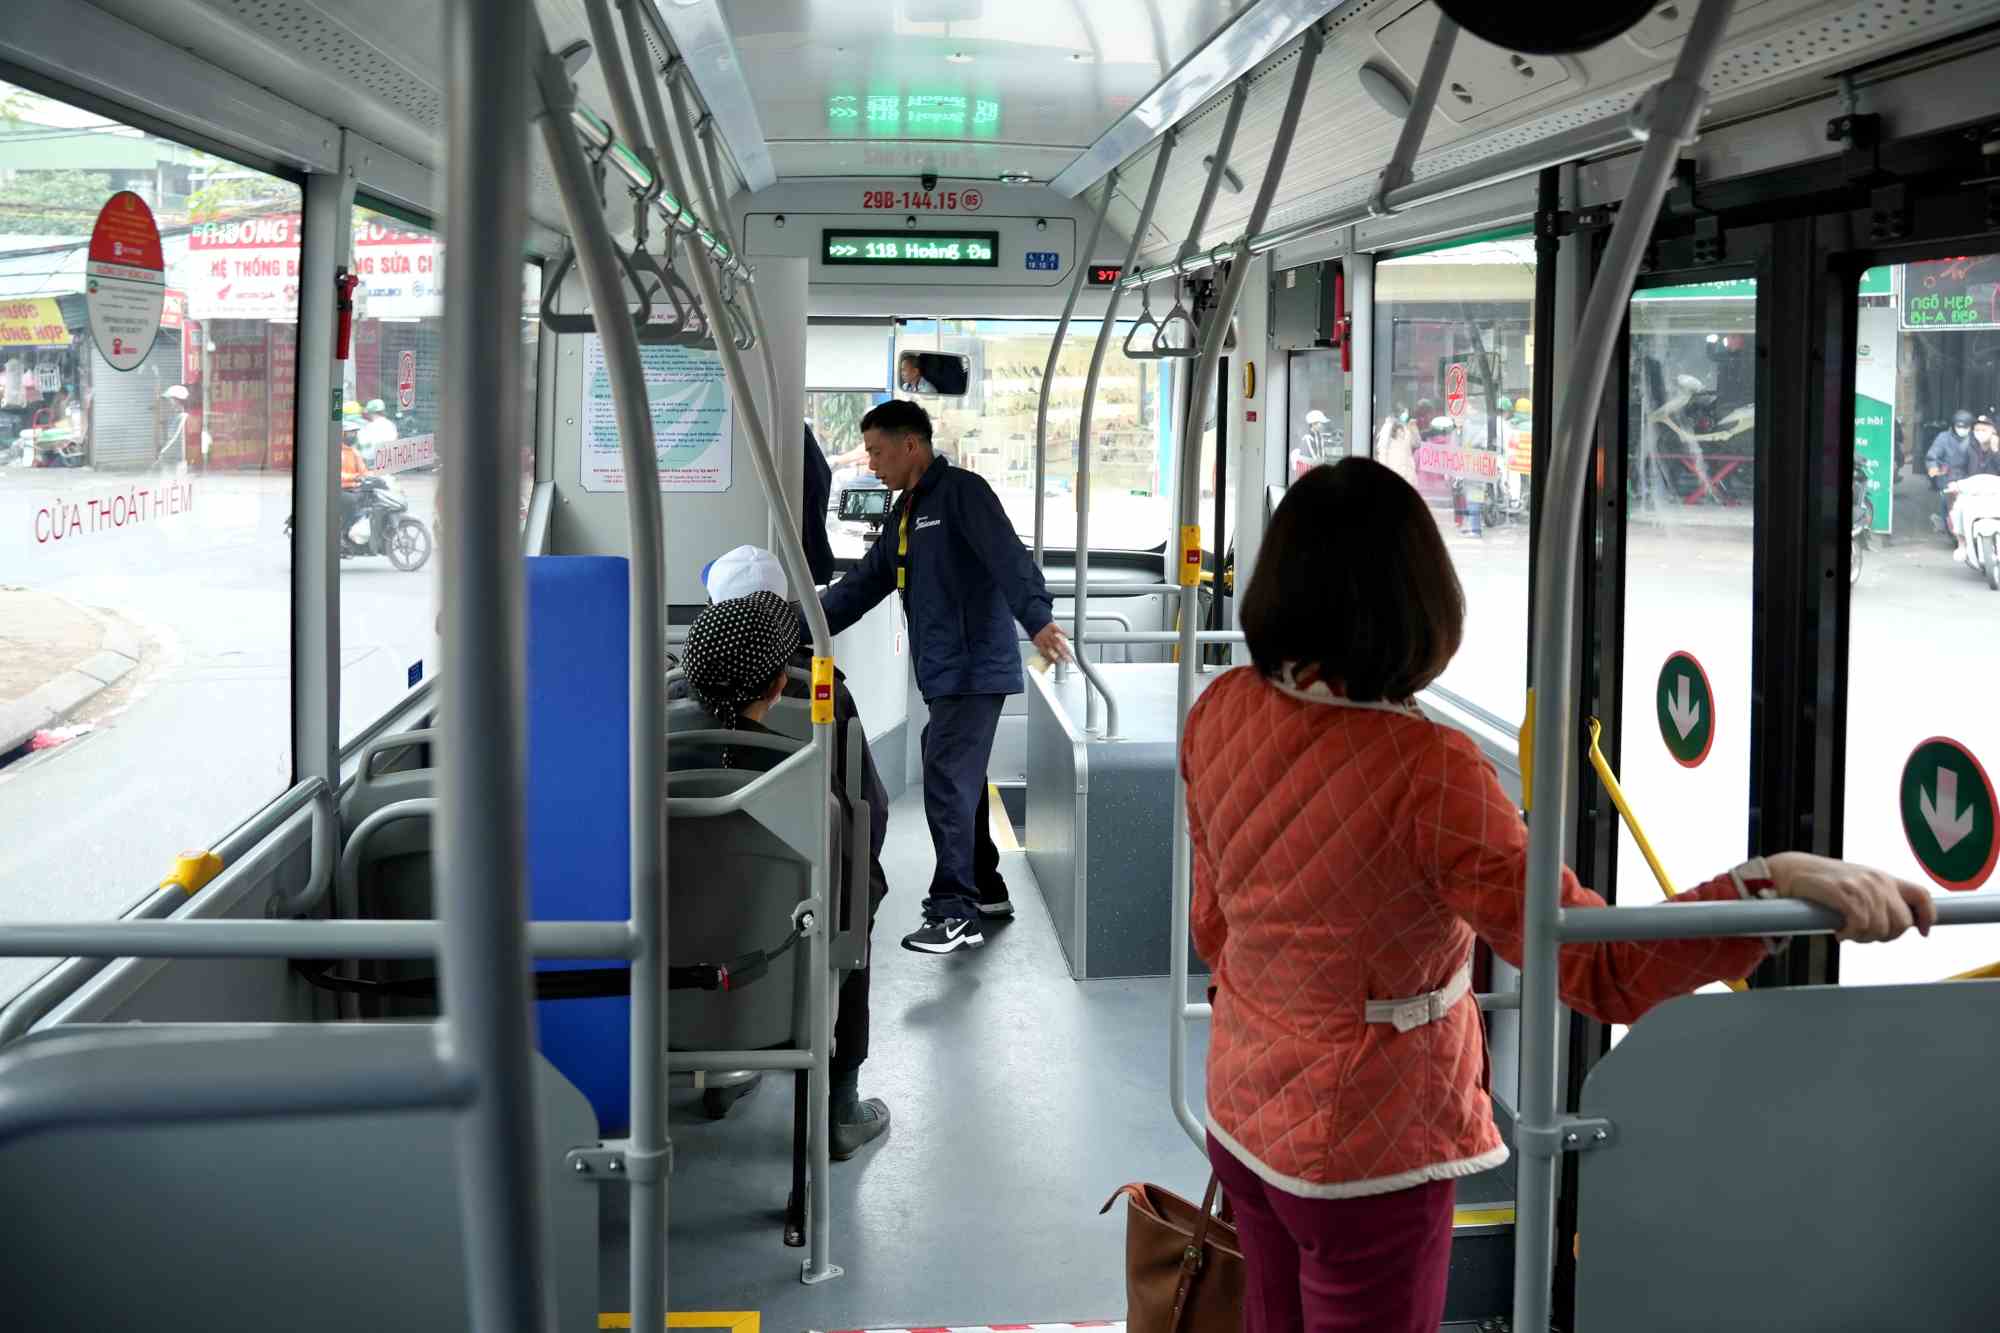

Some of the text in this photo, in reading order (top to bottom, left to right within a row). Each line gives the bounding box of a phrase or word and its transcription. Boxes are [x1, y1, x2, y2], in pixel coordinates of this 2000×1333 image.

[863, 191, 957, 209] 29B-144.15
[905, 242, 959, 260] Hoàng
[34, 479, 193, 544] CỬA THOÁT HIỂM
